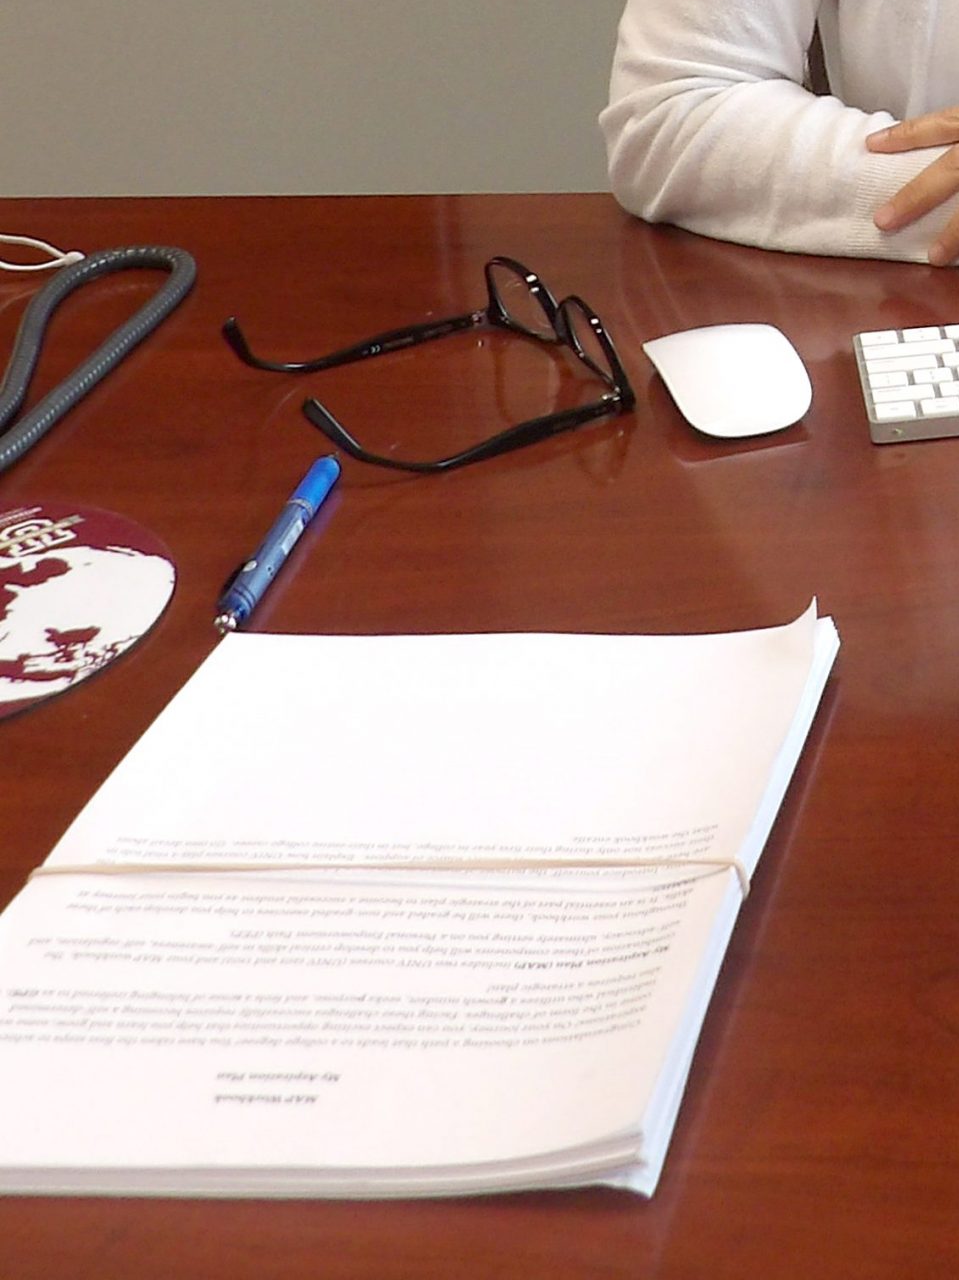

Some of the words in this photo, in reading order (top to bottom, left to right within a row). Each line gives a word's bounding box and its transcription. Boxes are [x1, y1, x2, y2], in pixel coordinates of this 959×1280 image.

[214, 1071, 246, 1080] Plan
[245, 1071, 320, 1081] Aspiration
[319, 1071, 342, 1081] My
[211, 1094, 283, 1102] Workbook
[282, 1094, 319, 1103] MAP
